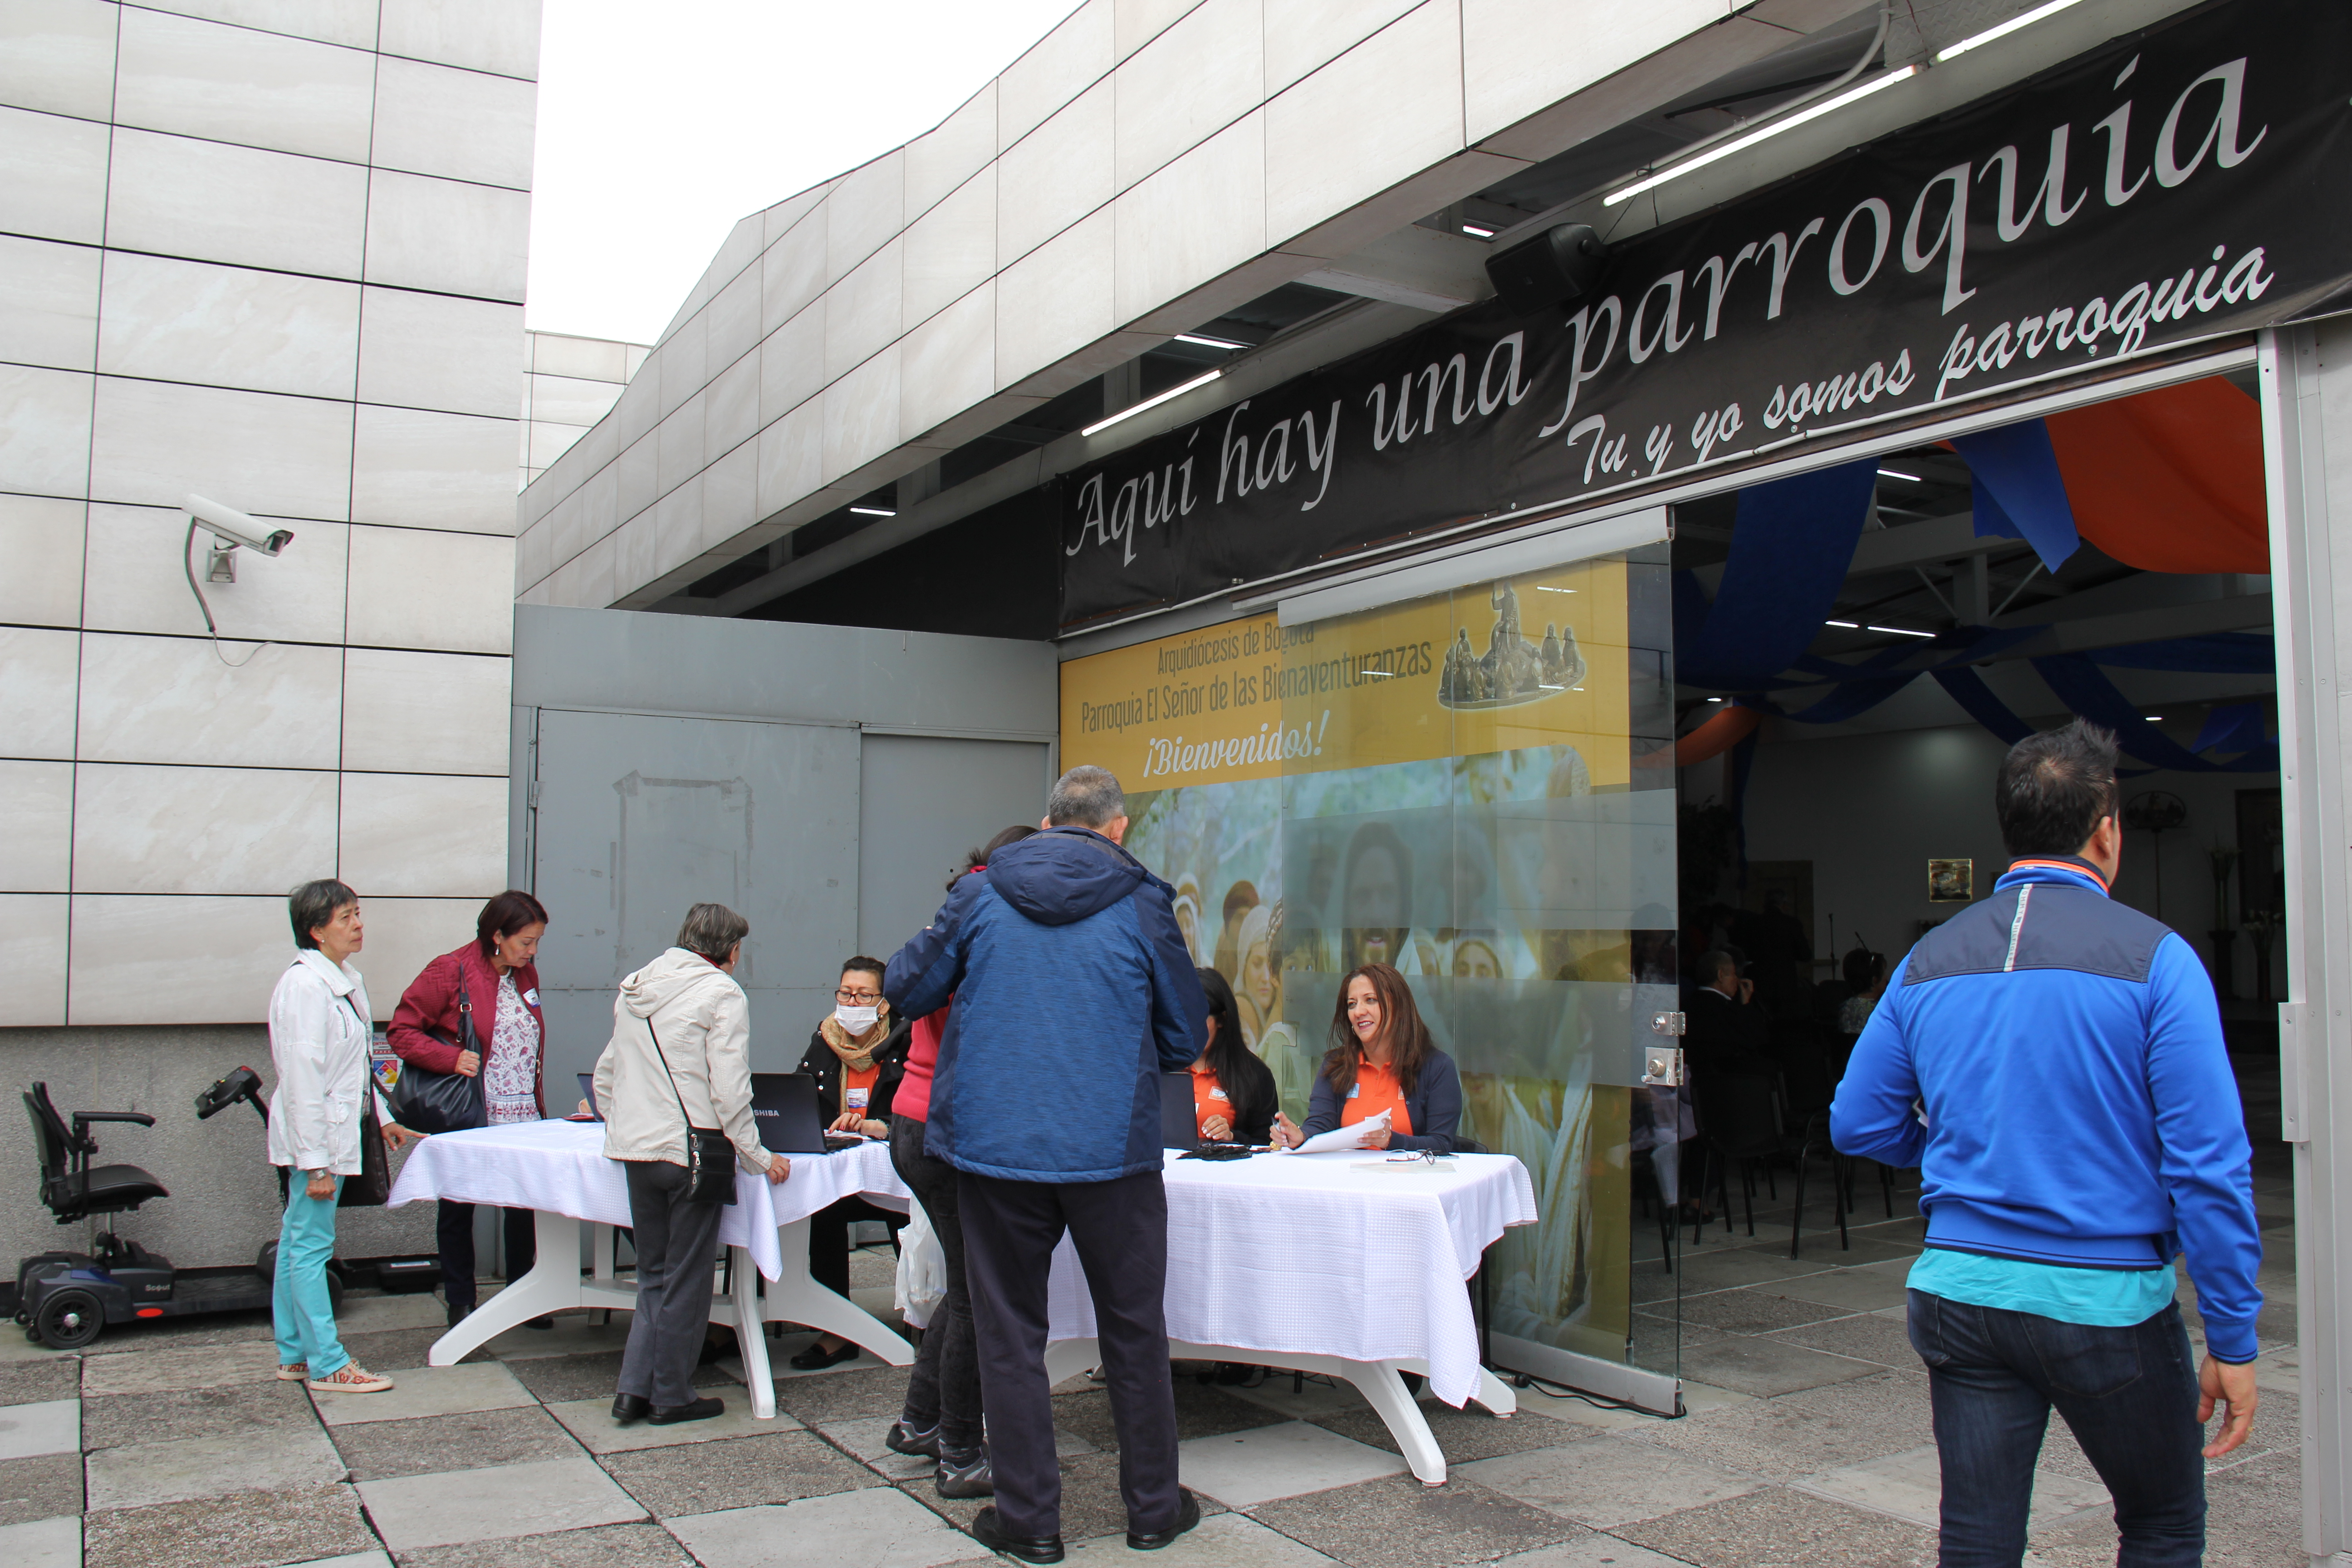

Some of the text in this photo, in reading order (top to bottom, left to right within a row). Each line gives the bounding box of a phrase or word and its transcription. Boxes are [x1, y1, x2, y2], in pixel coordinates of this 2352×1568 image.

[1066, 53, 2267, 567] Aquí hay una parroquía
[1568, 245, 2274, 485] Tu y yo somos parroquia
[1157, 630, 1239, 678] Arquidiócesis
[1244, 622, 1260, 657] de
[1082, 641, 1432, 734] Parroquia El Señor de las Bienaventuranzas
[1143, 709, 1330, 778] ¡Bienvenidos!
[2018, 891, 2029, 915] OMMY
[145, 1284, 171, 1292] Scout
